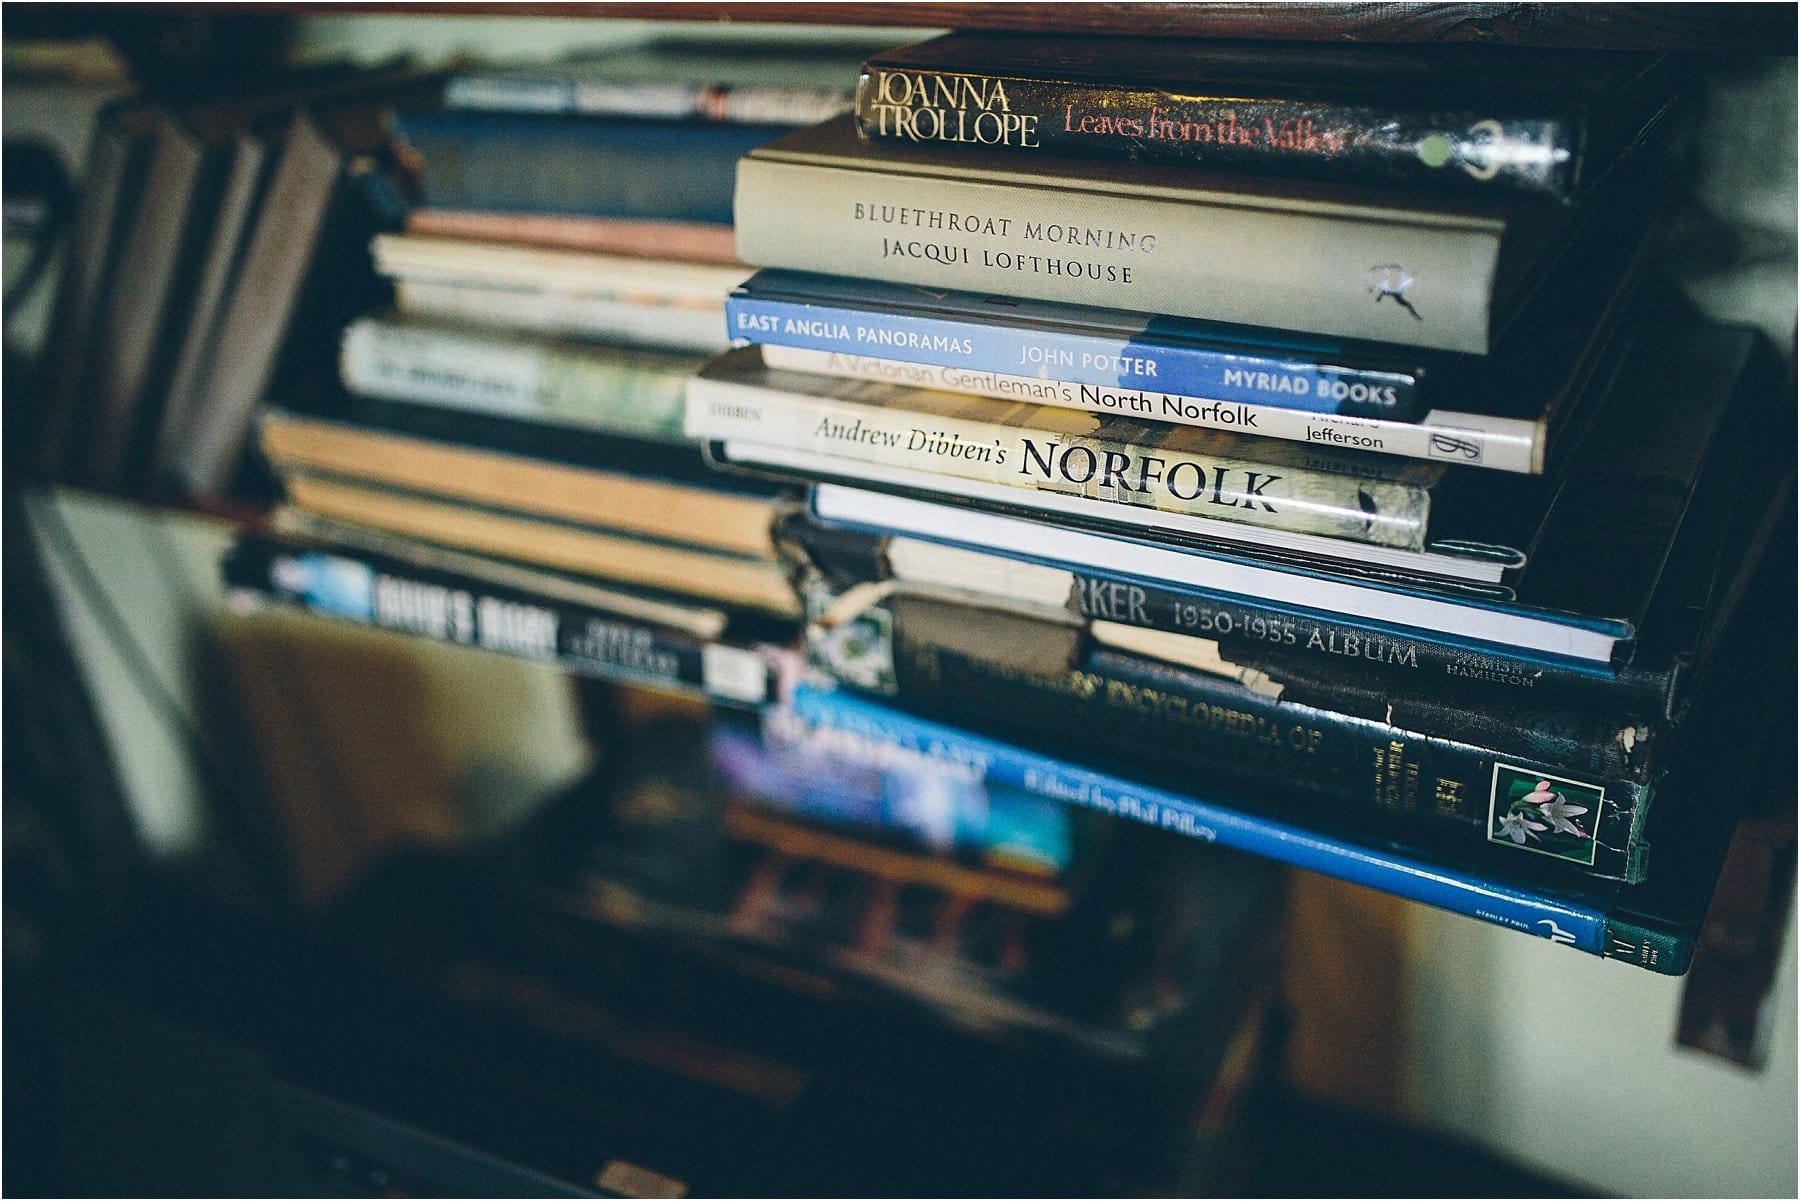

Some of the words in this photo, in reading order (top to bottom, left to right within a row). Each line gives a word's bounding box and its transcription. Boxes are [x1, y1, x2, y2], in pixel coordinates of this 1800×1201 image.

[875, 71, 1011, 112] JOANNA
[873, 105, 1040, 148] TROLLOPE
[1064, 104, 1142, 138] Leaves
[1148, 107, 1211, 145] from
[1216, 113, 1261, 148] the
[854, 203, 1013, 239] BLUETHROAT
[1024, 221, 1157, 255] MORNING
[881, 237, 970, 267] JACQUI
[983, 249, 1134, 285] LOFTHOUSE
[737, 312, 780, 333] EAST
[784, 317, 850, 341] ANGLIA
[857, 326, 973, 355] PANORAMAS
[1020, 345, 1074, 368] JOHN
[1083, 352, 1158, 378] POTTER
[942, 367, 1073, 403] Gentleman's
[1081, 385, 1153, 414] North
[1162, 394, 1258, 429] Norfolk
[1224, 367, 1310, 395] MYRIAD
[1317, 378, 1398, 406] BOOKS
[1306, 425, 1384, 449] Jefferson
[814, 416, 902, 448] Andrew
[907, 428, 1008, 465] Dibben's
[1019, 439, 1285, 513] NORFOLK
[1174, 602, 1298, 645] 1950-1955
[1306, 627, 1420, 669] ALBUM
[1446, 664, 1534, 687] HAMILTON
